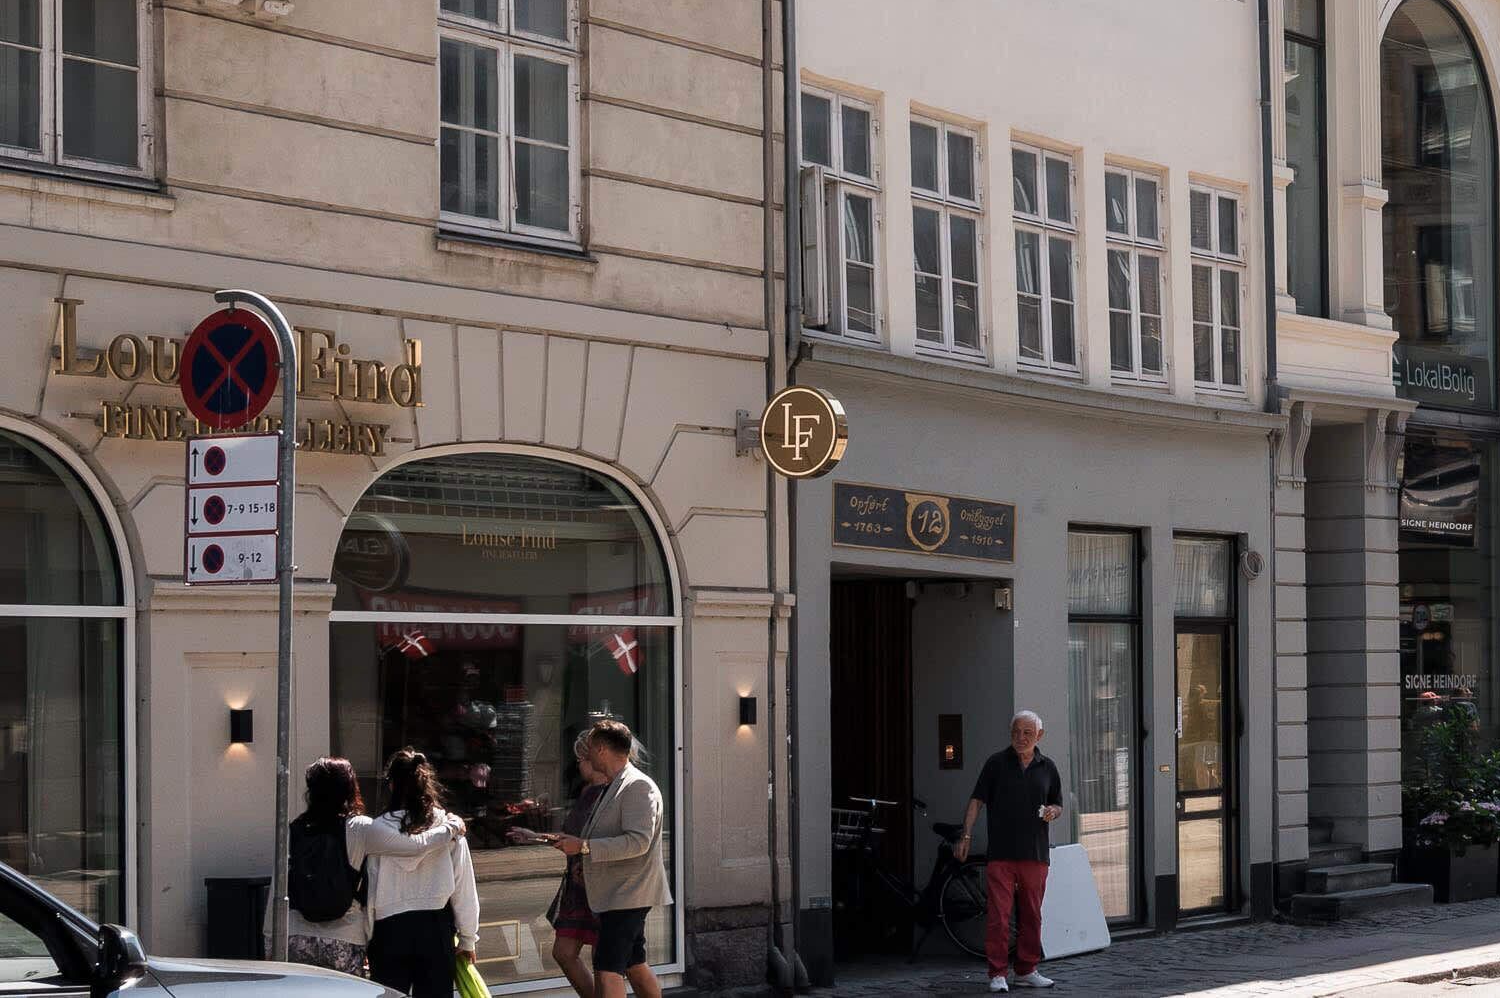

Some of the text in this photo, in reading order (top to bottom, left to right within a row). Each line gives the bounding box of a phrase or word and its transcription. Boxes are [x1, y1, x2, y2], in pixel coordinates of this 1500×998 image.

[292, 326, 426, 409] Find
[1406, 359, 1475, 400] LokalBolig
[100, 401, 187, 442] FINE
[782, 403, 820, 460] LF
[228, 503, 275, 514] 7-9 15-18
[854, 521, 881, 533] 1763
[918, 508, 943, 534] 12
[1401, 519, 1473, 531] SIGNE HEINDORF
[462, 522, 515, 547] Louise
[971, 534, 993, 546] 1910
[239, 553, 262, 563] 9-12
[1405, 674, 1477, 689] SIGNE HEINDORF
